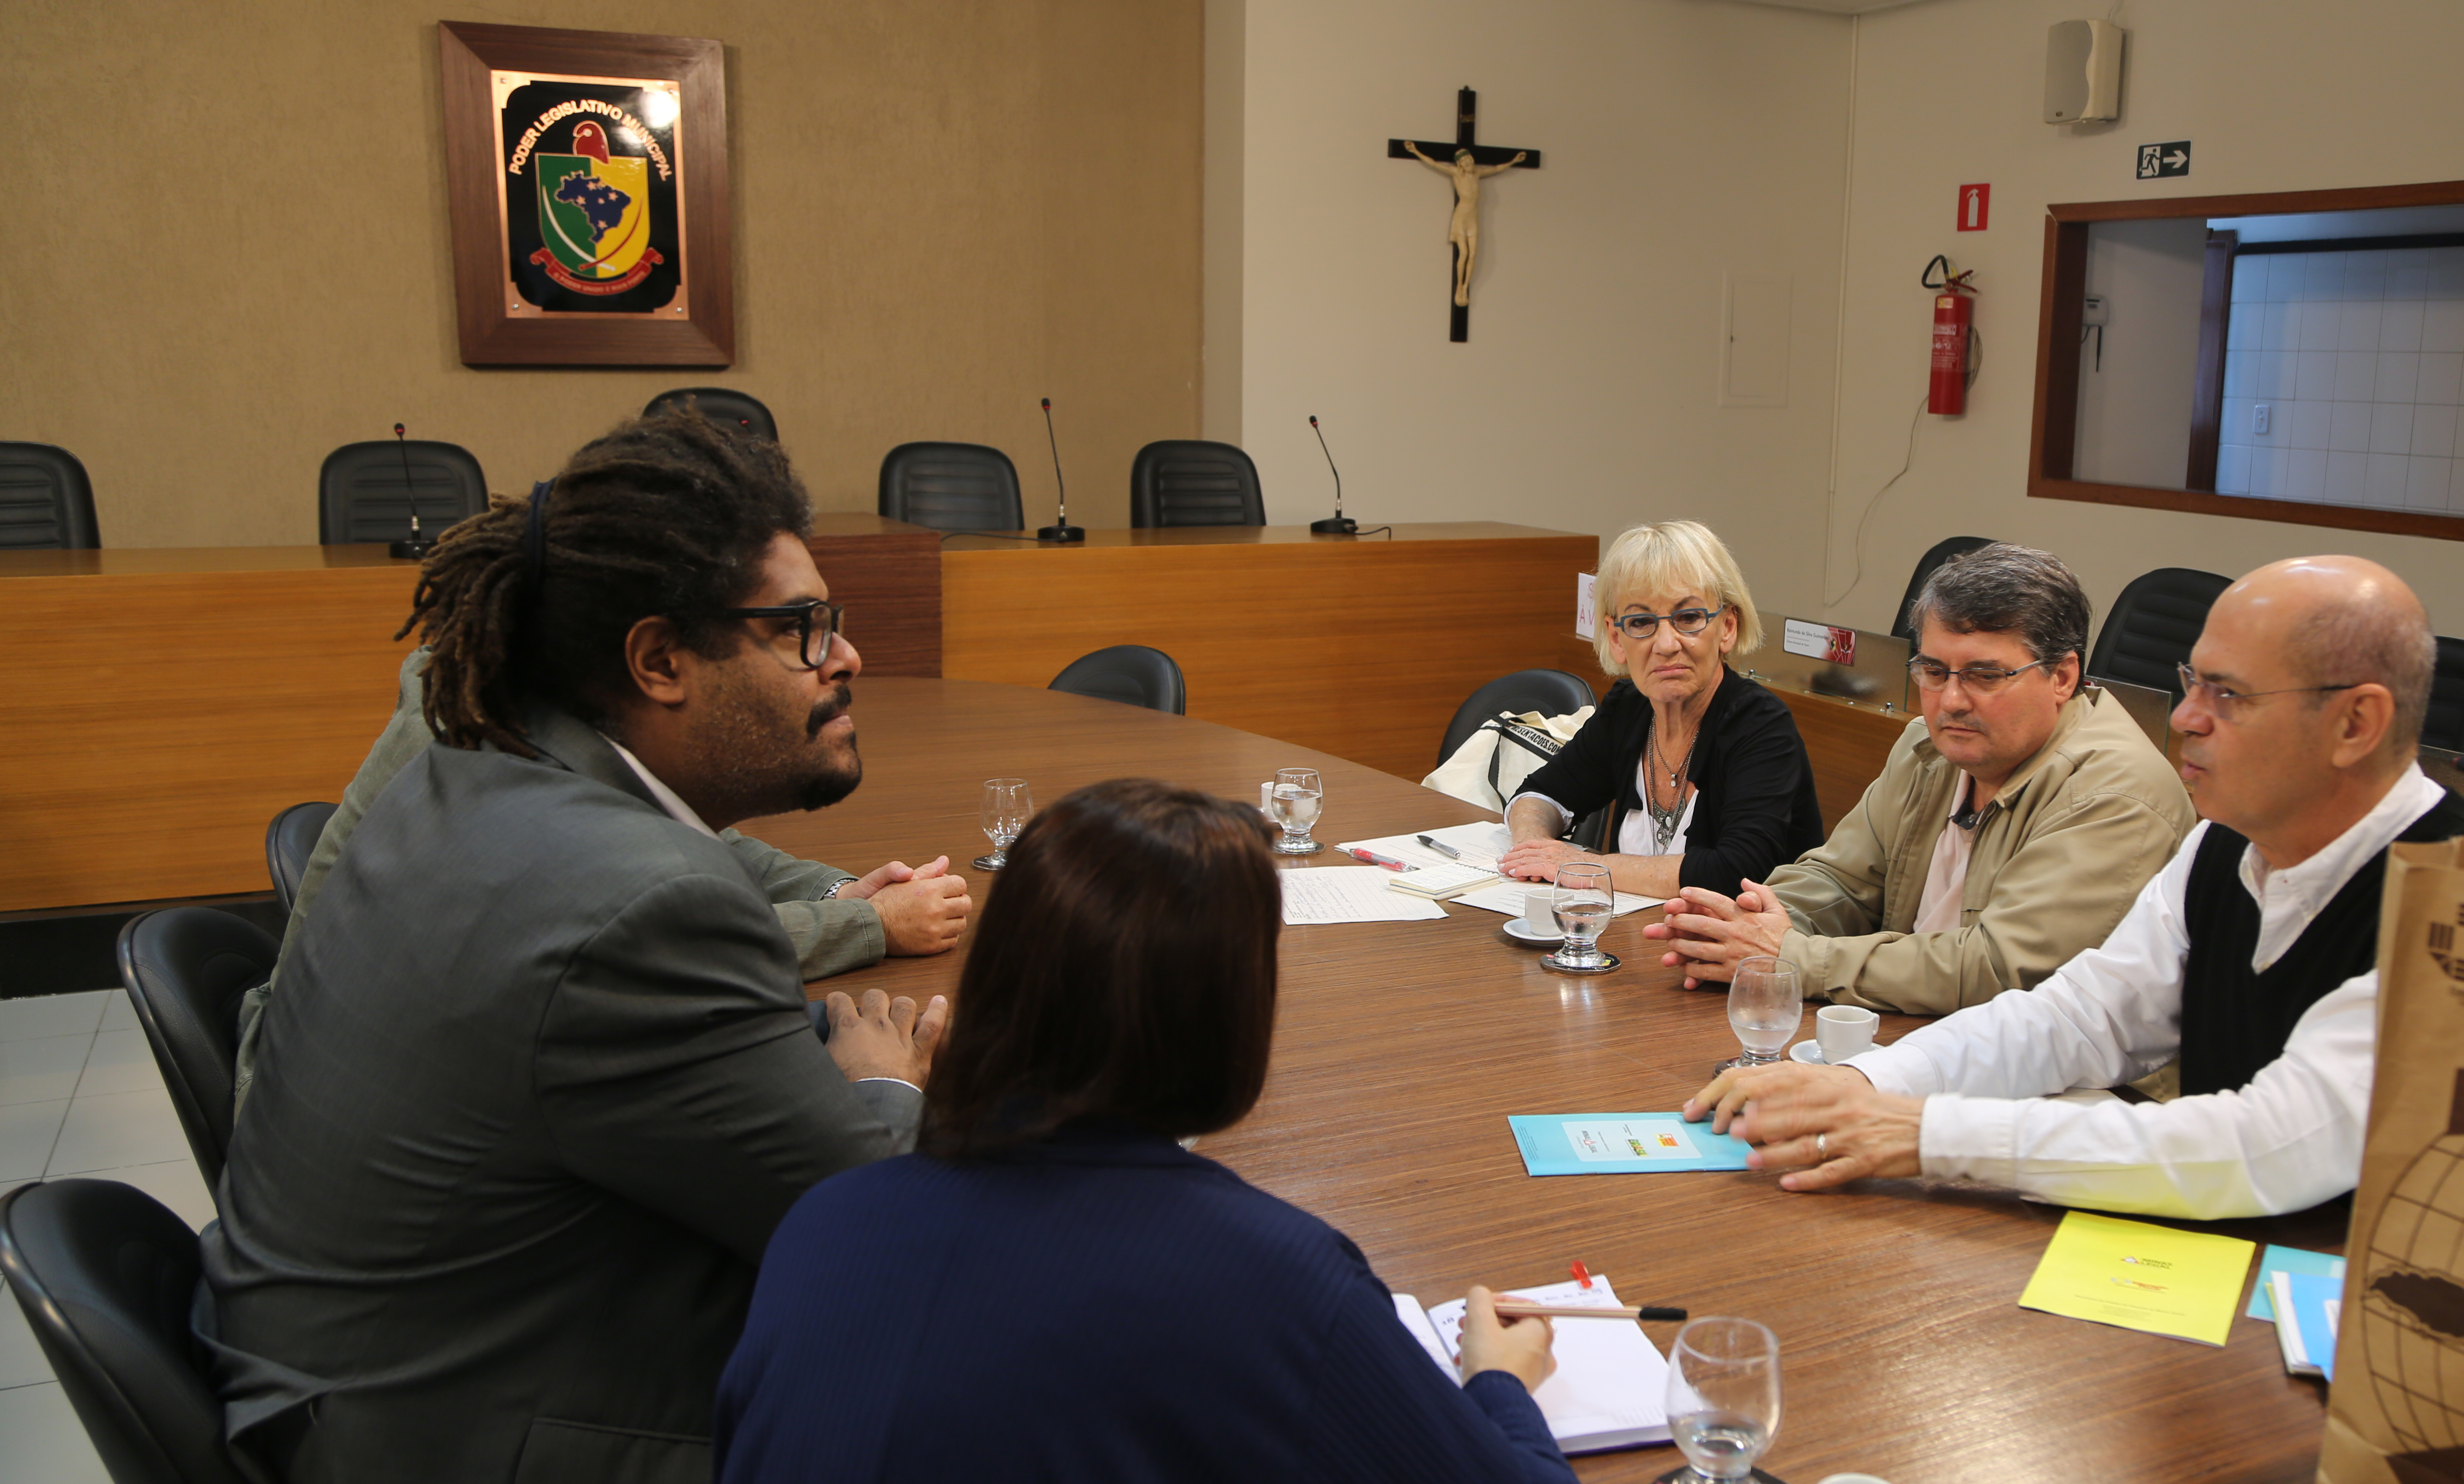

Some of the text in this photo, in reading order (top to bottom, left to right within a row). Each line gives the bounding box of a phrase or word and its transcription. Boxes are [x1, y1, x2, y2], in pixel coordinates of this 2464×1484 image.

[508, 99, 673, 182] PODER LEGISLATIVO MUNICIPAL
